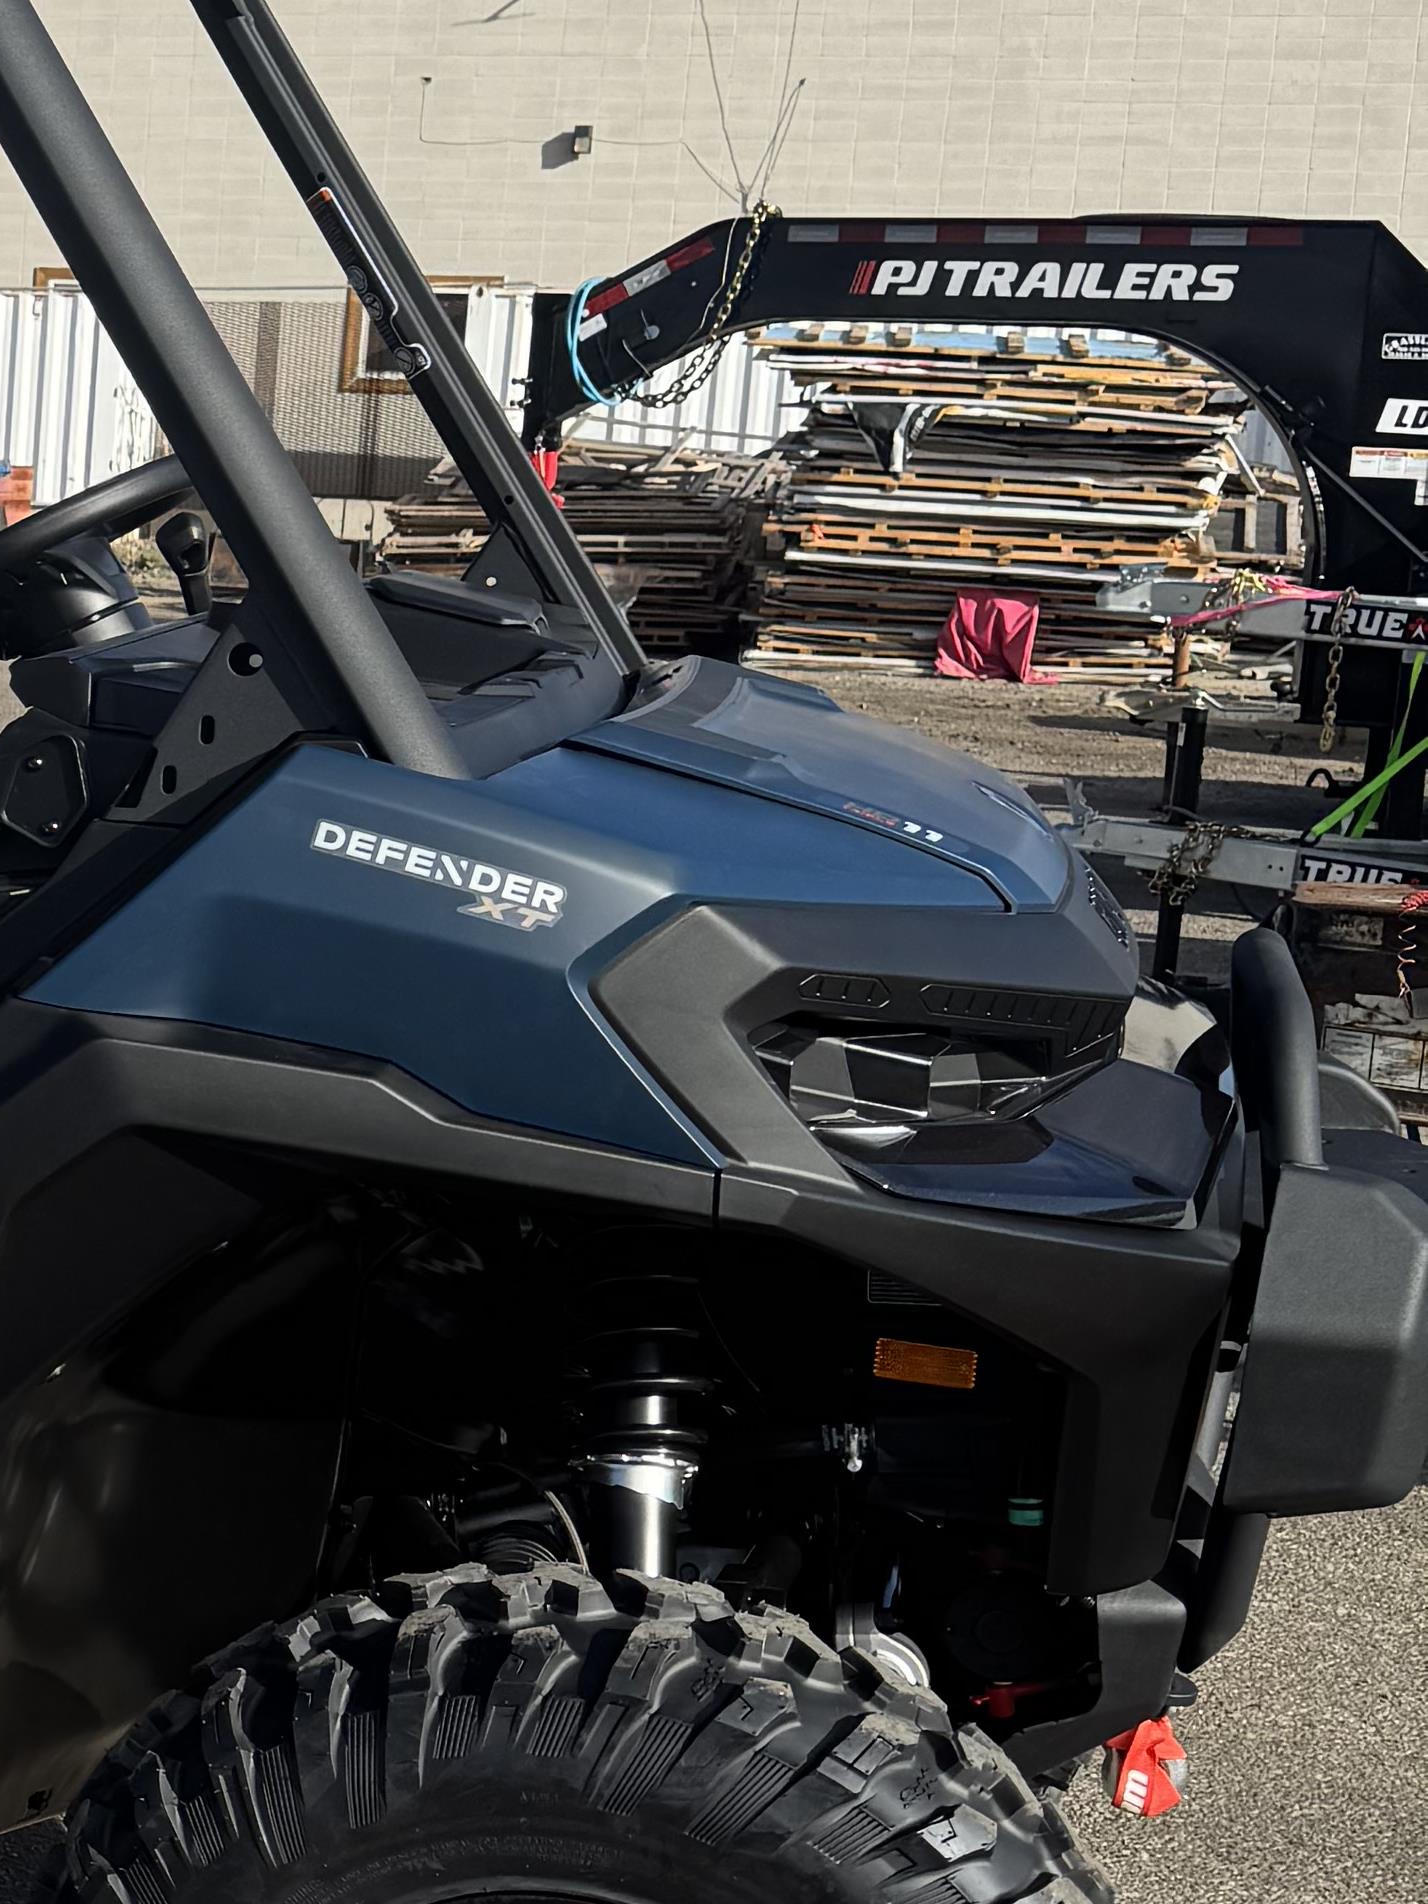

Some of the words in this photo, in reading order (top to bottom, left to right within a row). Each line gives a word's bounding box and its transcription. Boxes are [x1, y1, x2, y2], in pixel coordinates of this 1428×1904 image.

[871, 260, 938, 297] PJ
[944, 261, 1240, 302] TRAILERS
[1310, 603, 1409, 639] TRUE
[313, 821, 565, 914] DEFENDER
[467, 895, 556, 929] XT
